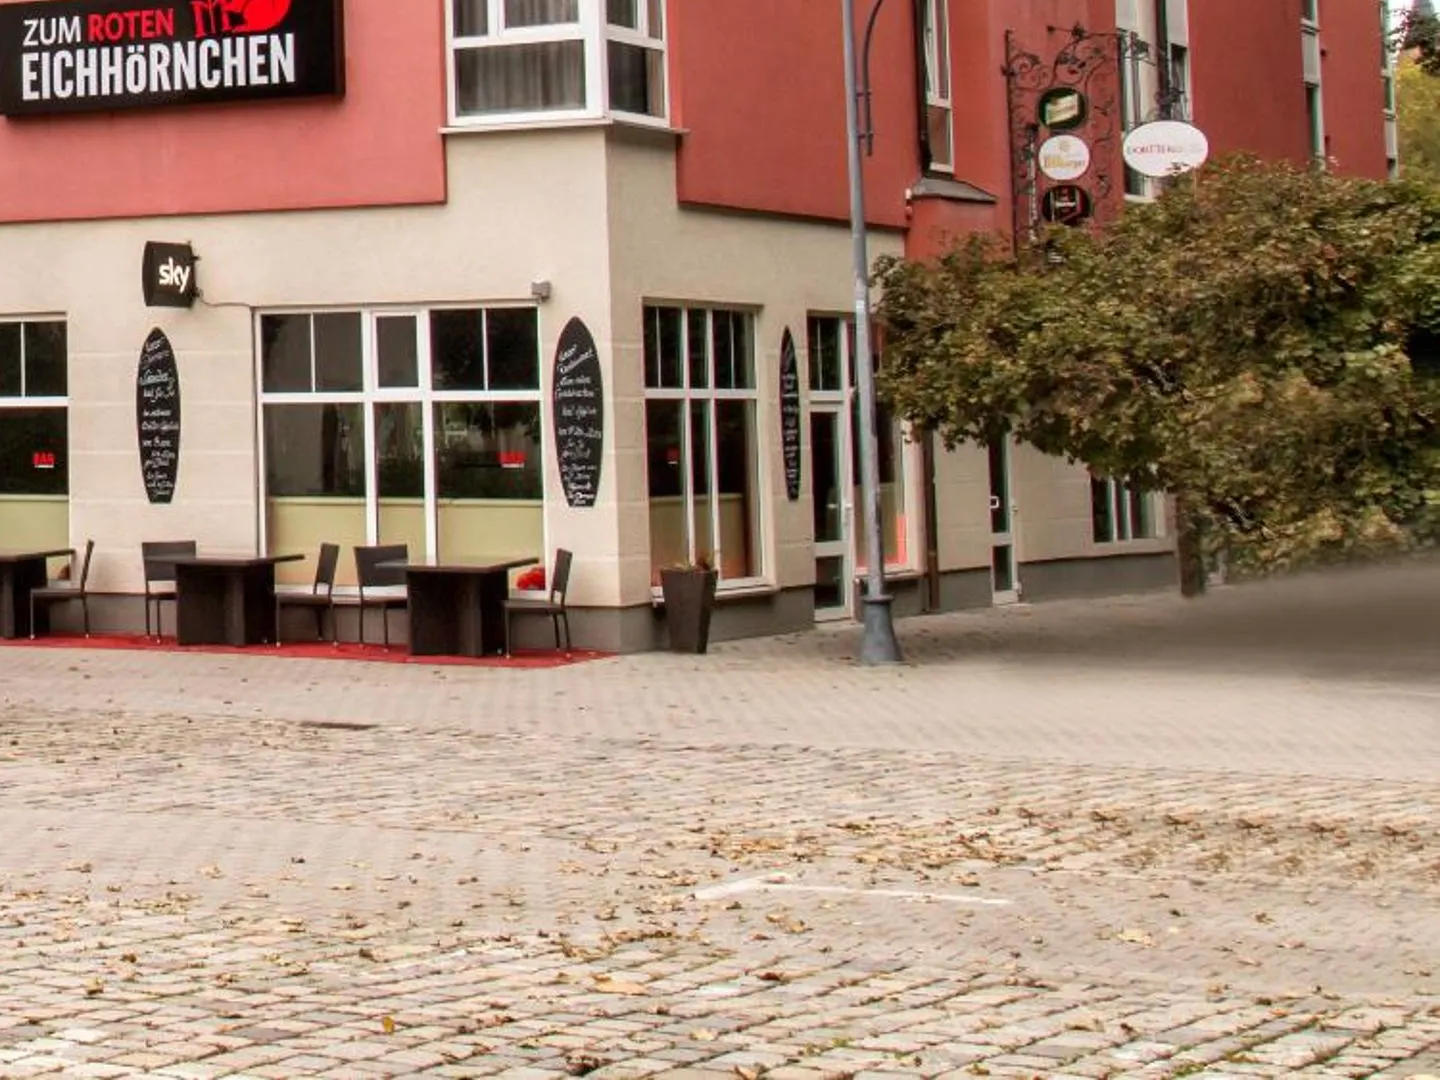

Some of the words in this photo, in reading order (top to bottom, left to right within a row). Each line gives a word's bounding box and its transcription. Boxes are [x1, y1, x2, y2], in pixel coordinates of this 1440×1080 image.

[23, 16, 82, 46] ZUM
[87, 8, 175, 43] ROTEN
[158, 256, 191, 294] sky
